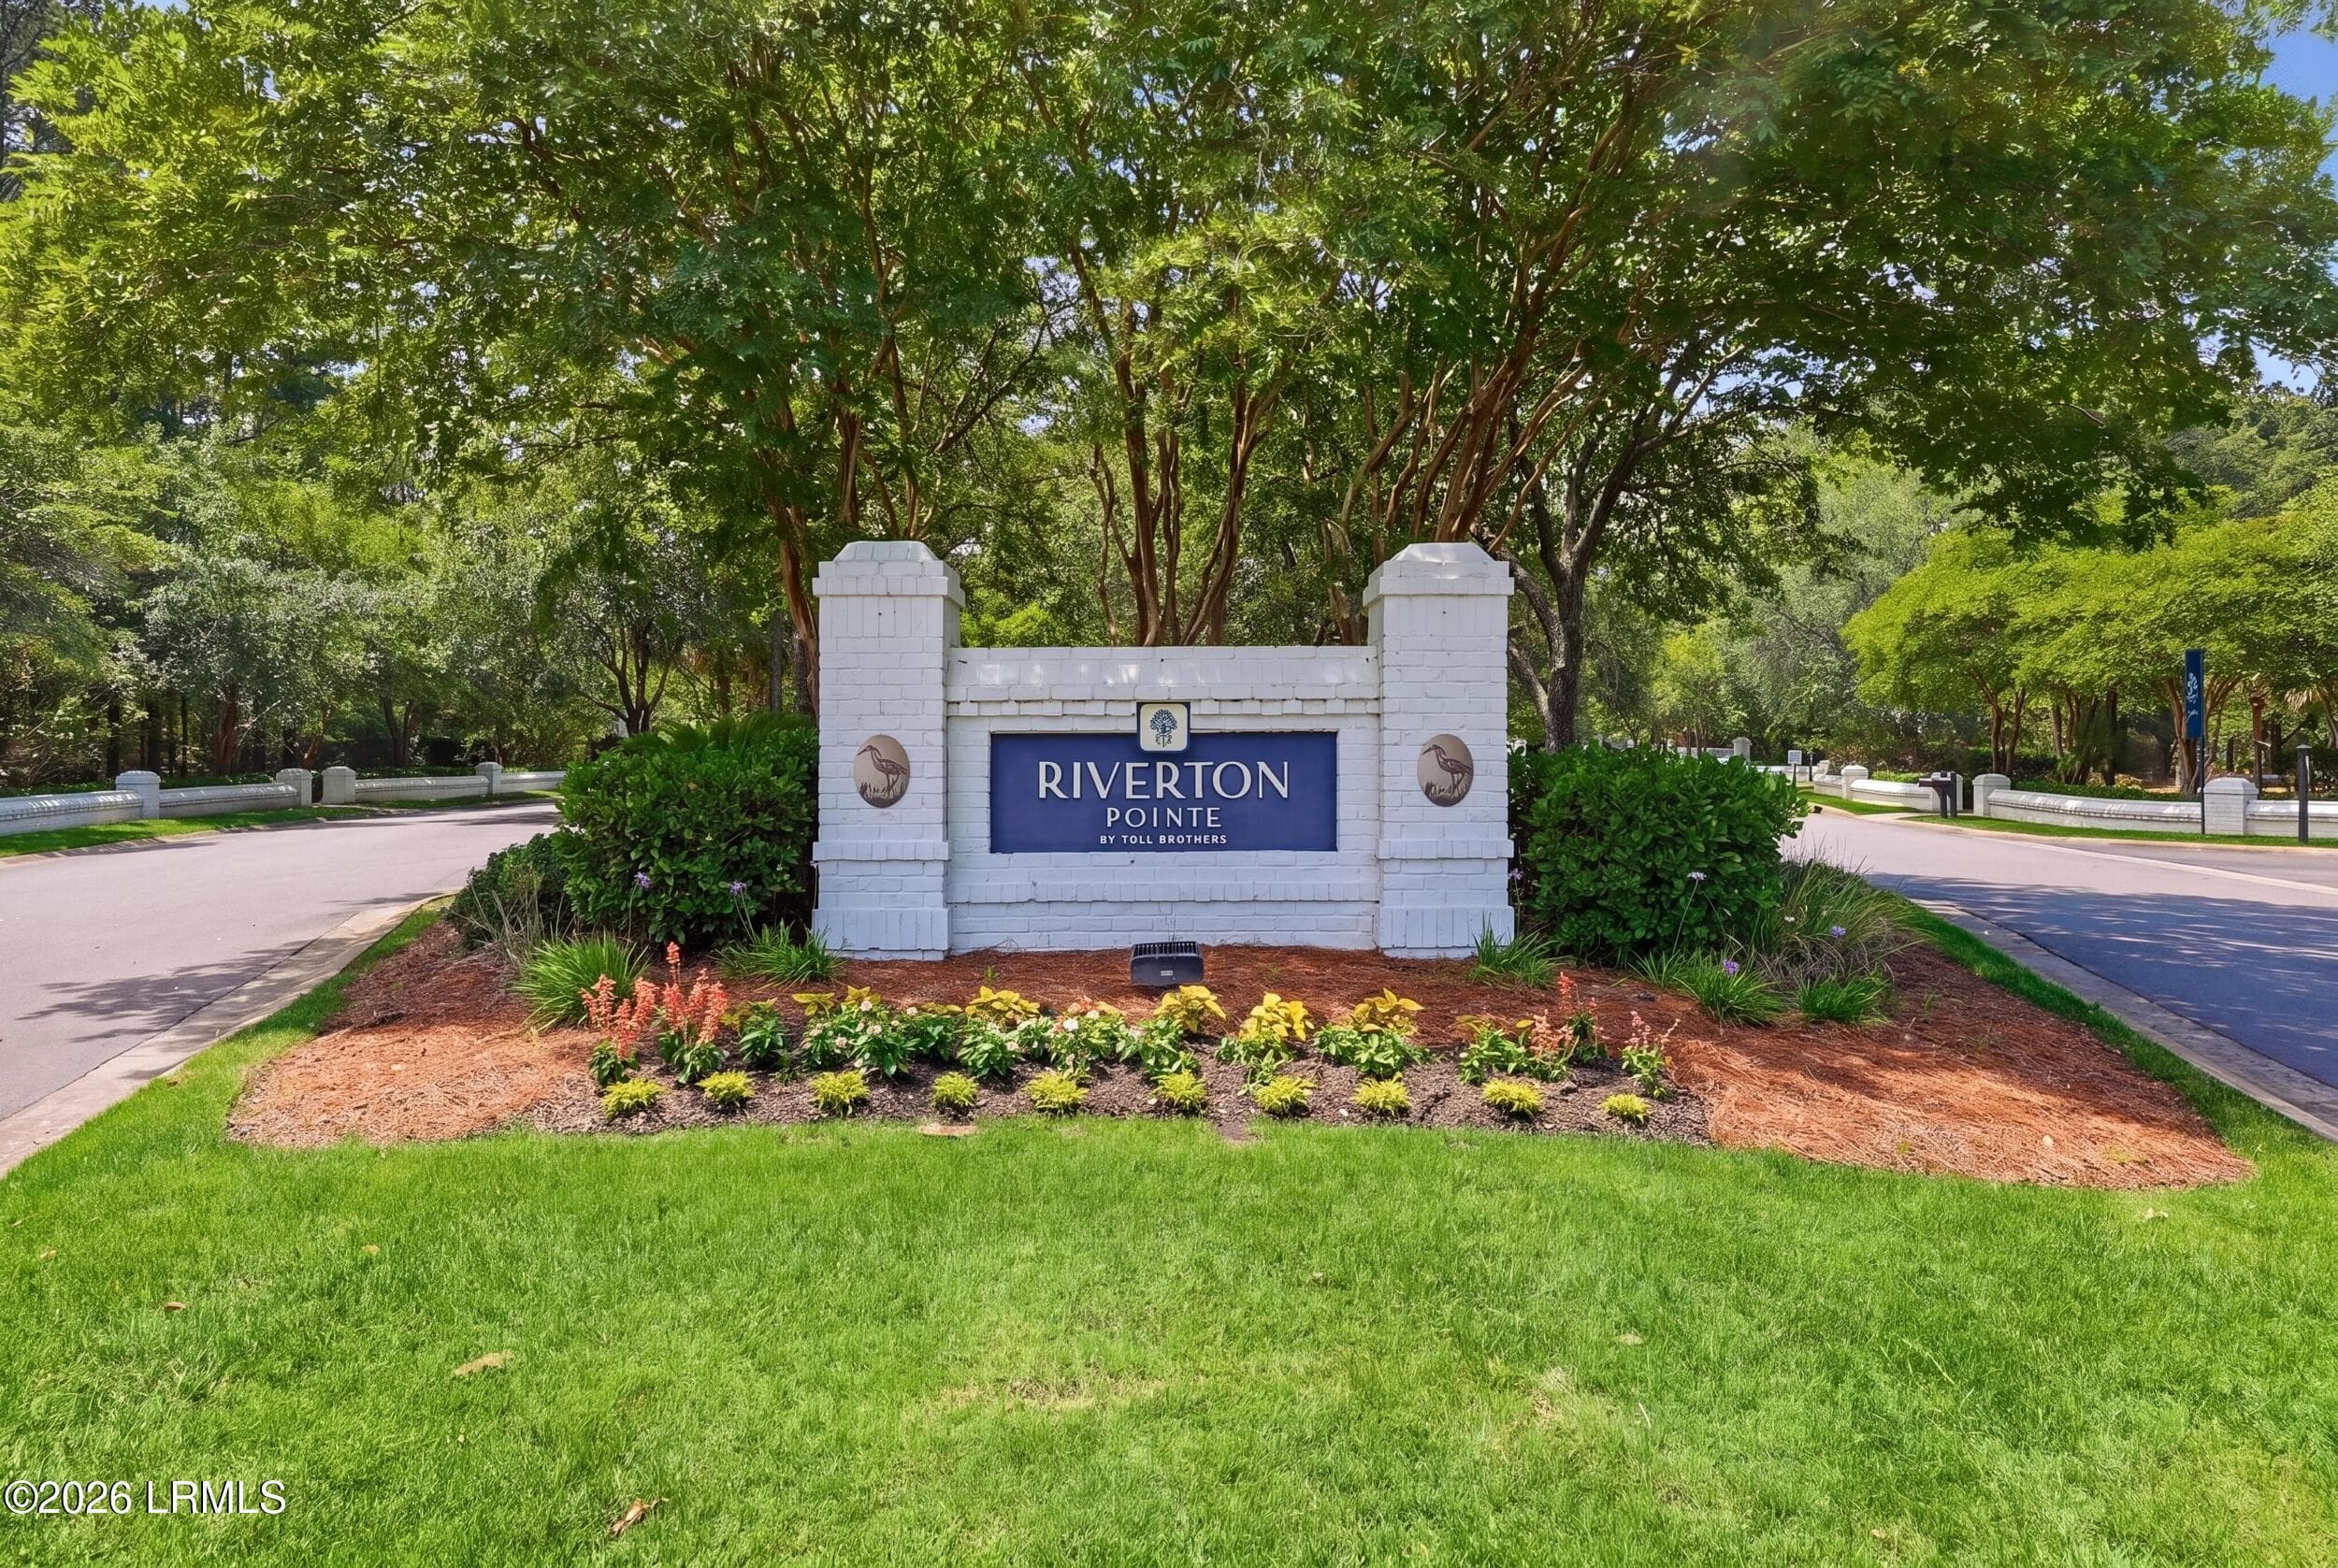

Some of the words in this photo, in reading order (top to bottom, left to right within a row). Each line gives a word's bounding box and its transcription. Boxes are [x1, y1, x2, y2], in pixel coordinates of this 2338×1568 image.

[1038, 761, 1290, 799] RIVERTON
[1106, 807, 1222, 828] POINTE
[1100, 835, 1116, 844] BY
[1121, 835, 1153, 844] TOLL
[1159, 835, 1227, 844] BROTHERS
